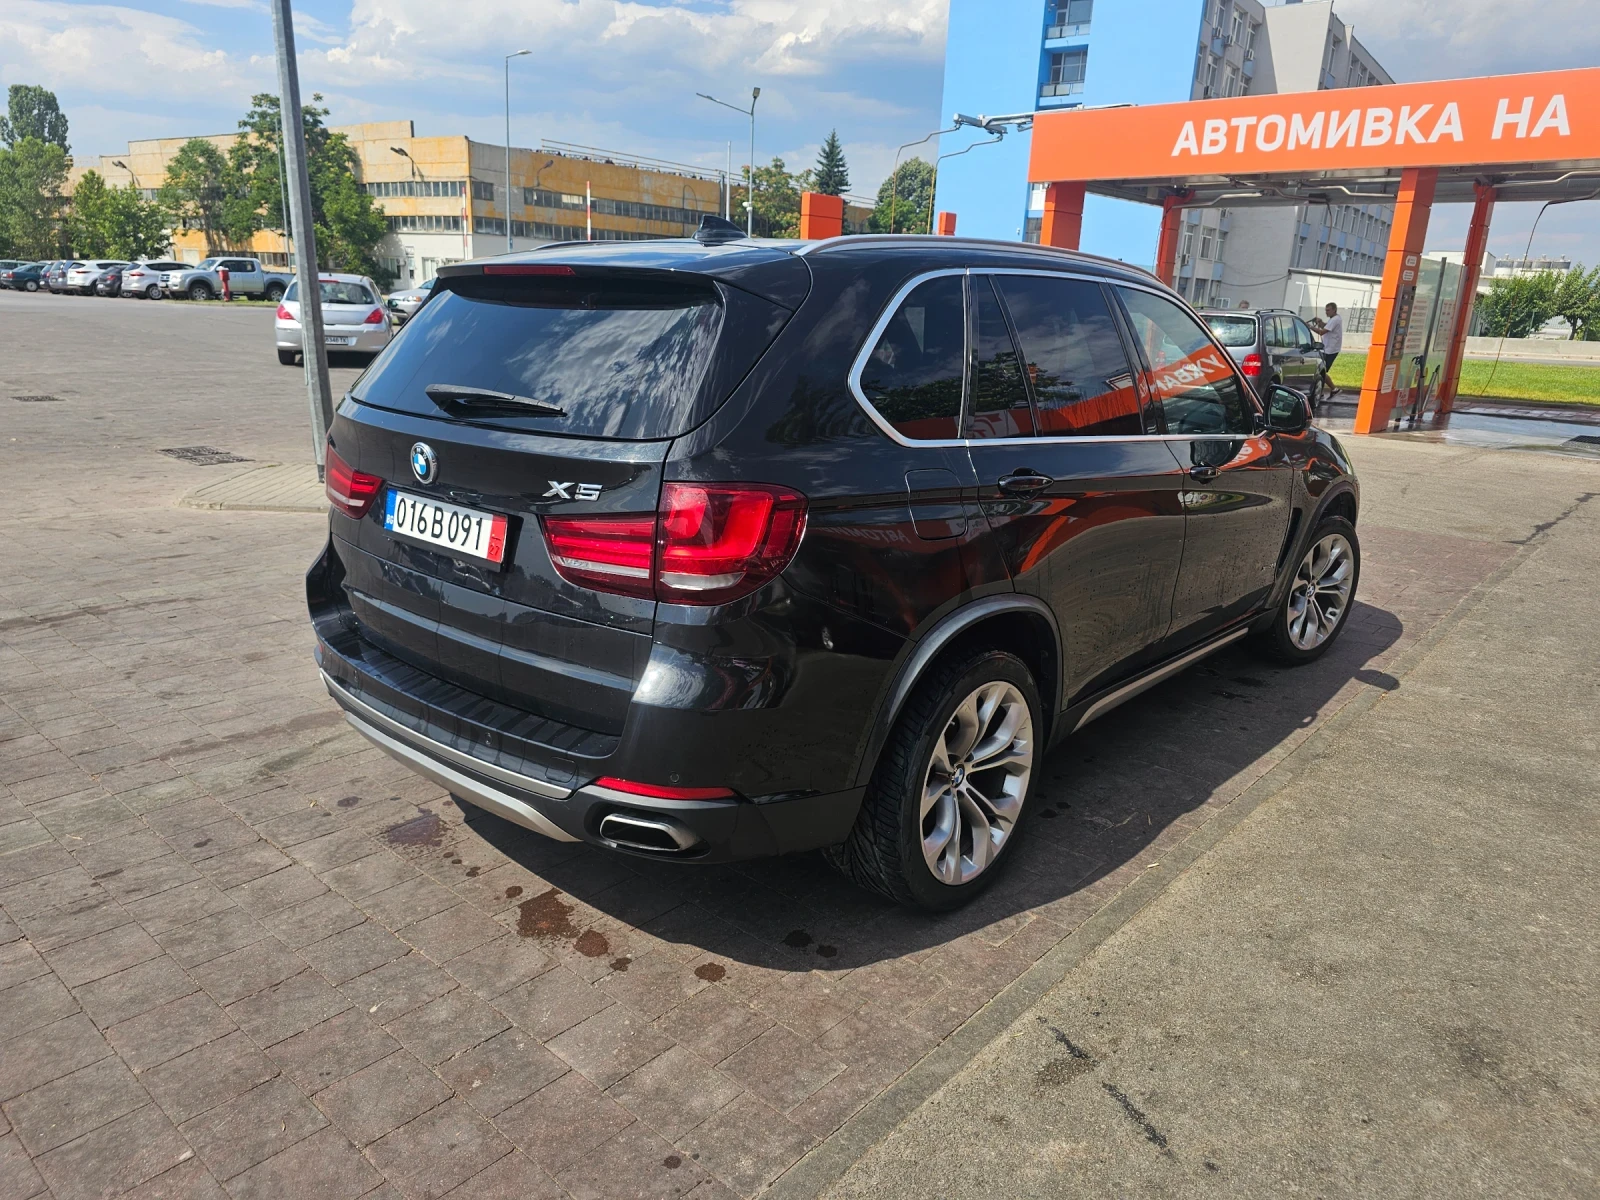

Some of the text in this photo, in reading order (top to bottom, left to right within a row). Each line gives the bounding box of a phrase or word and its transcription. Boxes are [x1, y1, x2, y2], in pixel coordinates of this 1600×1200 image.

[1170, 93, 1571, 157] АВТОМИВКА НА
[541, 480, 604, 502] X5
[386, 513, 395, 525] BG
[488, 544, 500, 556] 27
